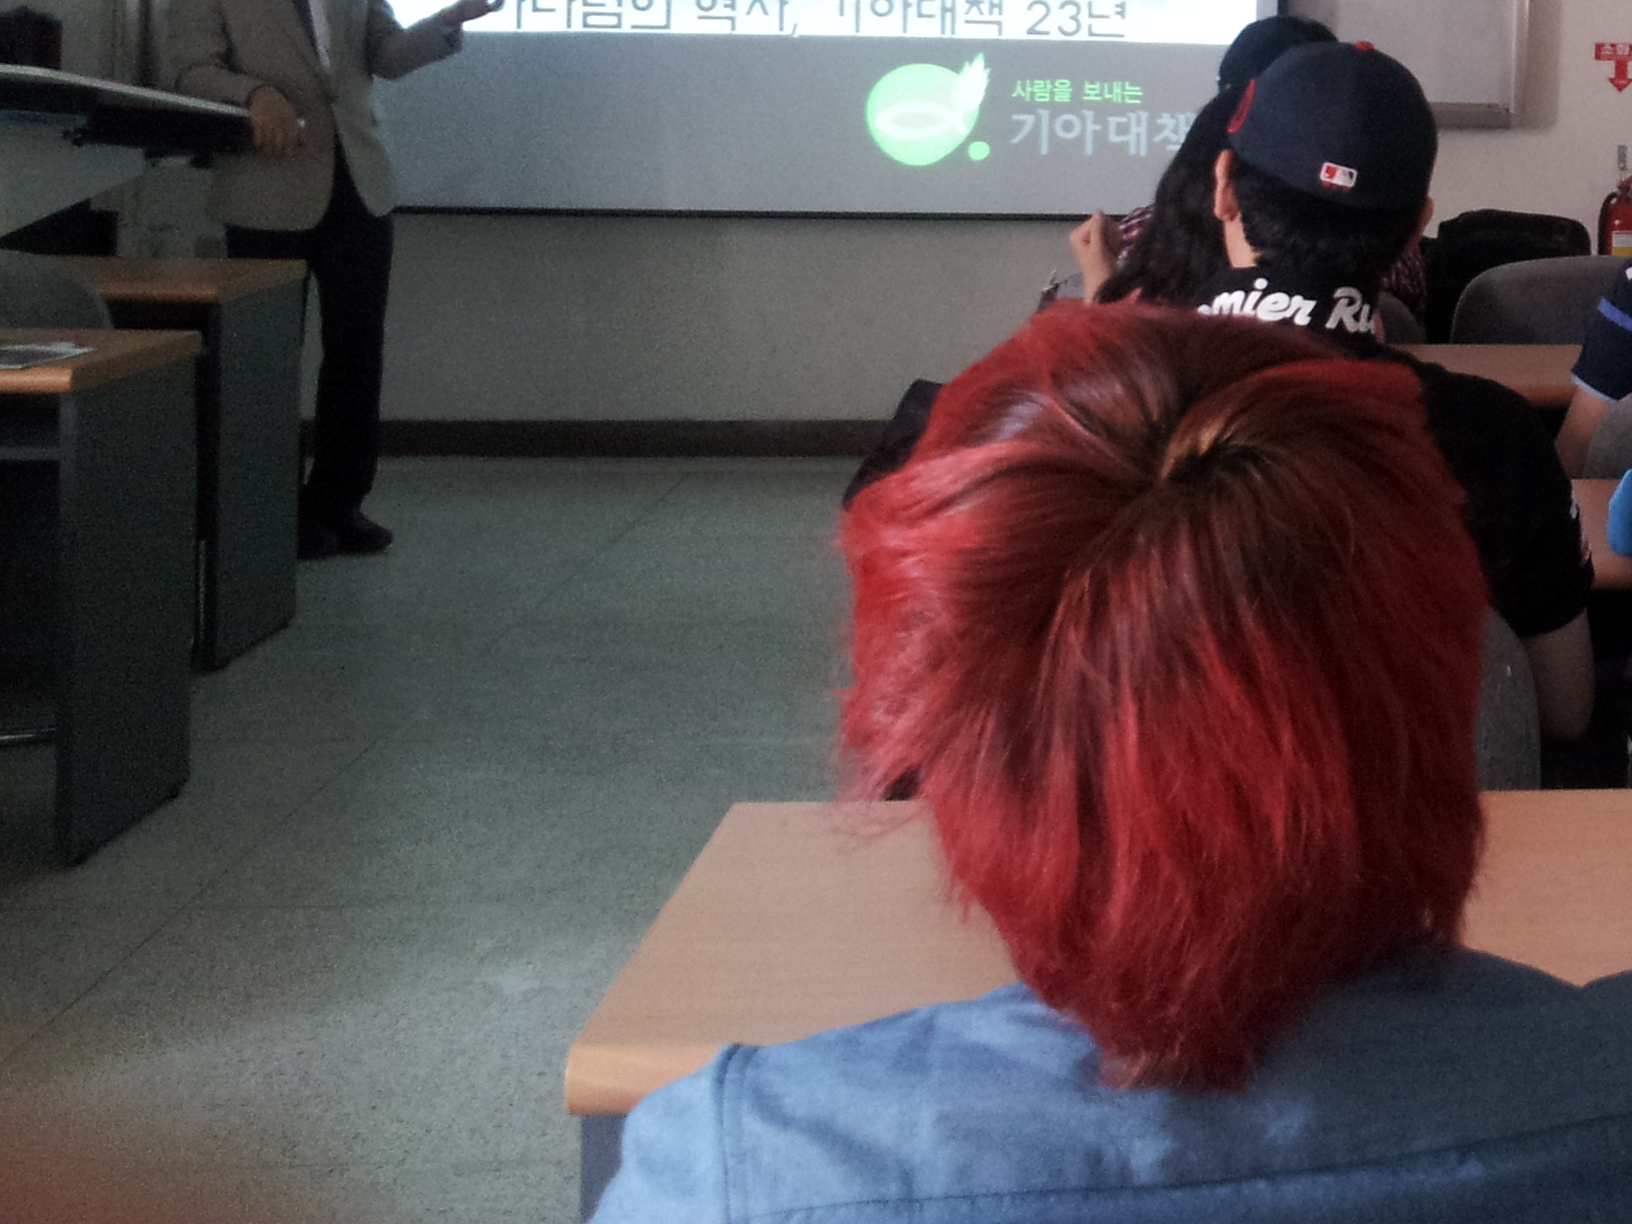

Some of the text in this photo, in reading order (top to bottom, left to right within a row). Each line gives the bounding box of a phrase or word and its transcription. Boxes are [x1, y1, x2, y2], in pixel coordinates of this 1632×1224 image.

[1011, 79, 1144, 104] 사람을 보내는
[1197, 277, 1317, 326] mier
